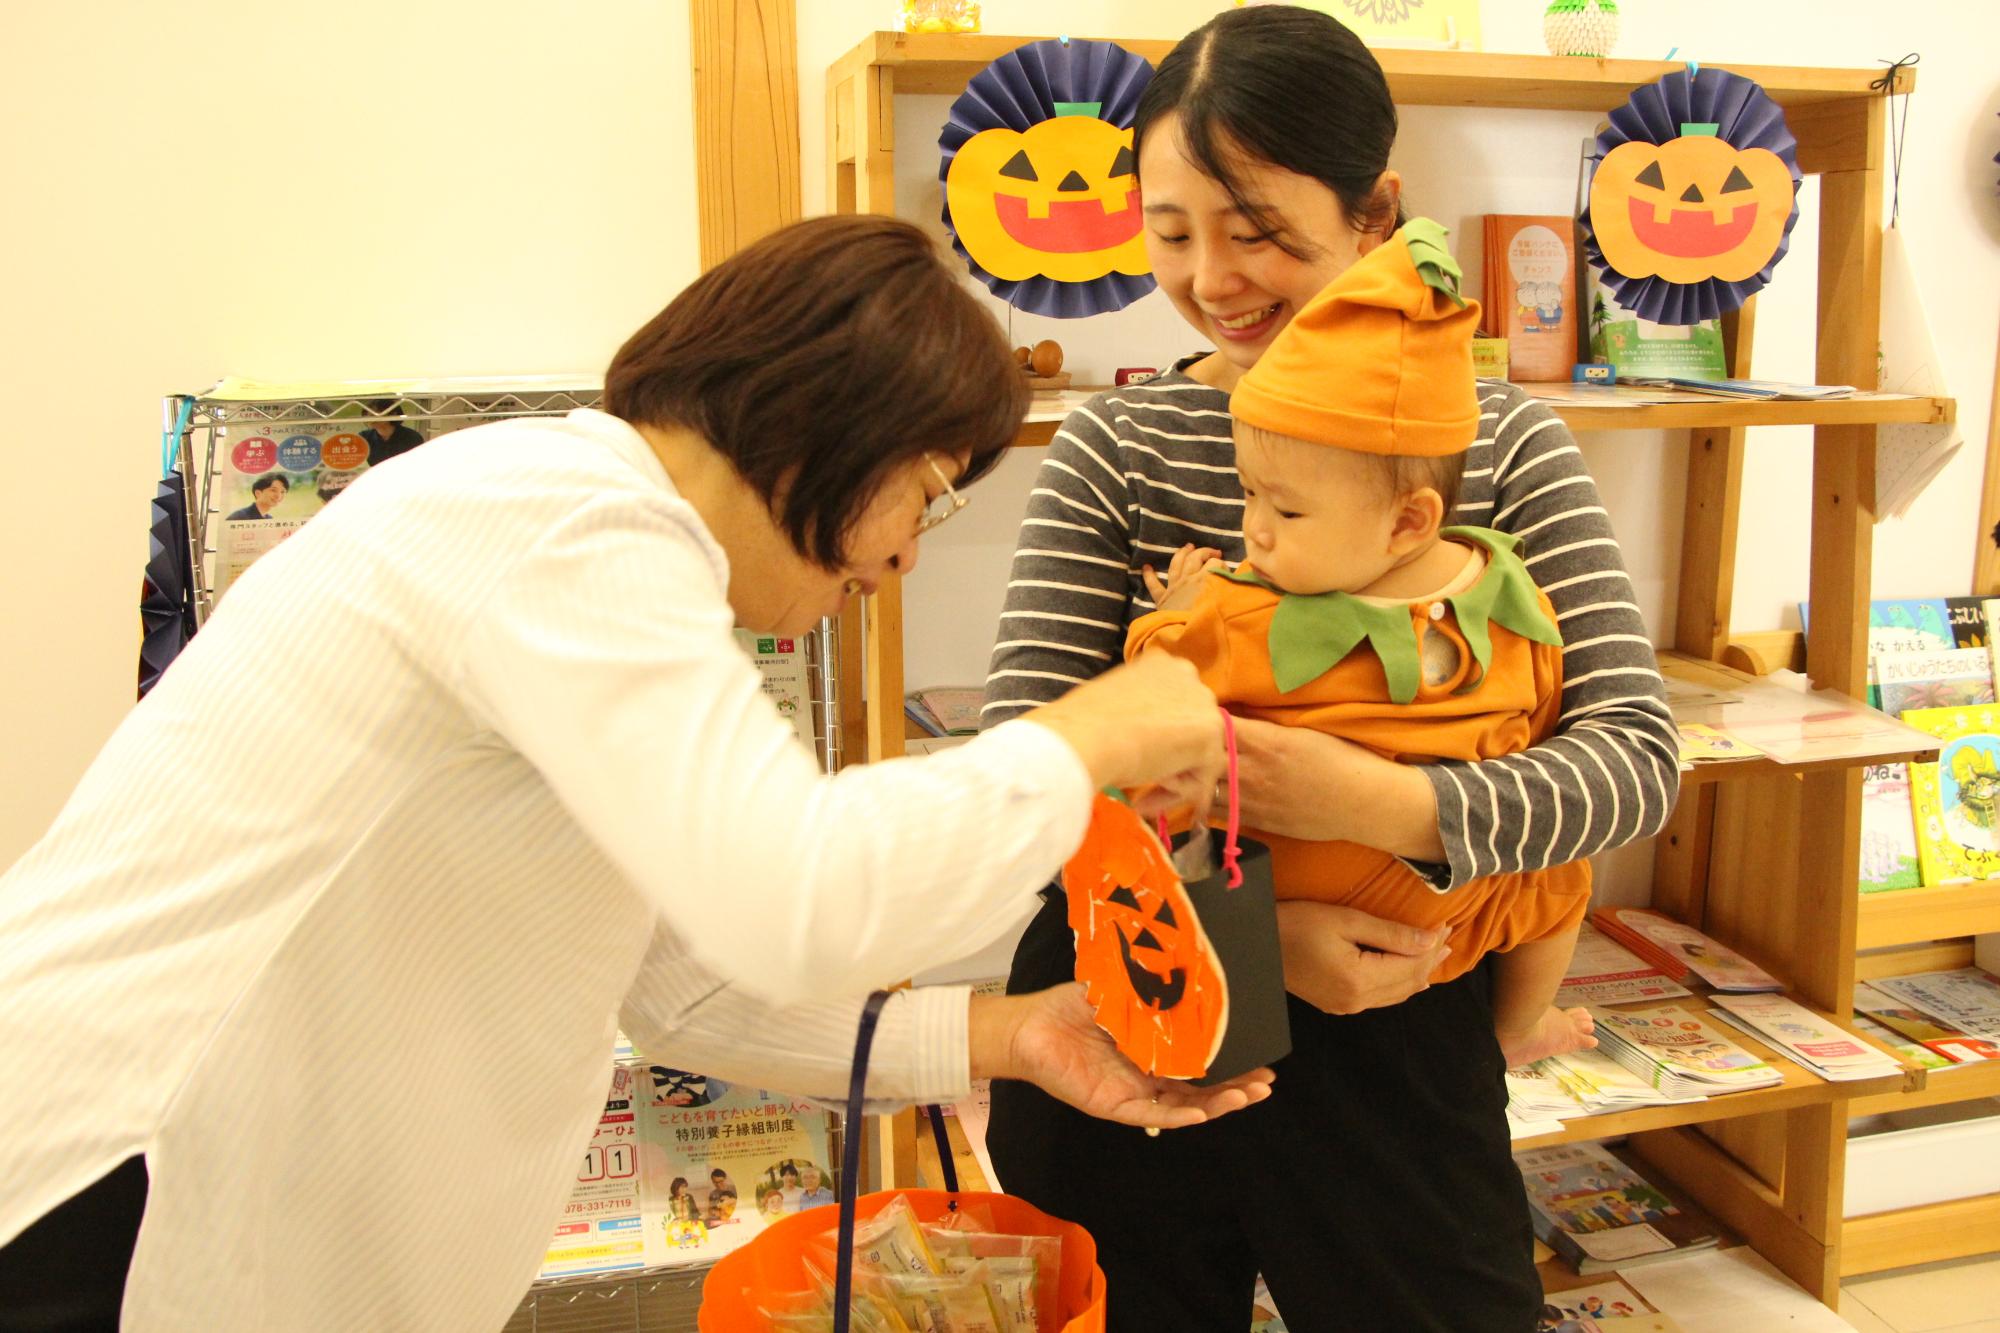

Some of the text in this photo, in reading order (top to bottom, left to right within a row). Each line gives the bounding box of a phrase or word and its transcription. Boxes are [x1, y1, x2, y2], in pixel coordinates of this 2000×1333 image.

[658, 1102, 811, 1126] こどもを育てたいと願う人へ
[675, 1119, 796, 1142] 特別養子縁組制度
